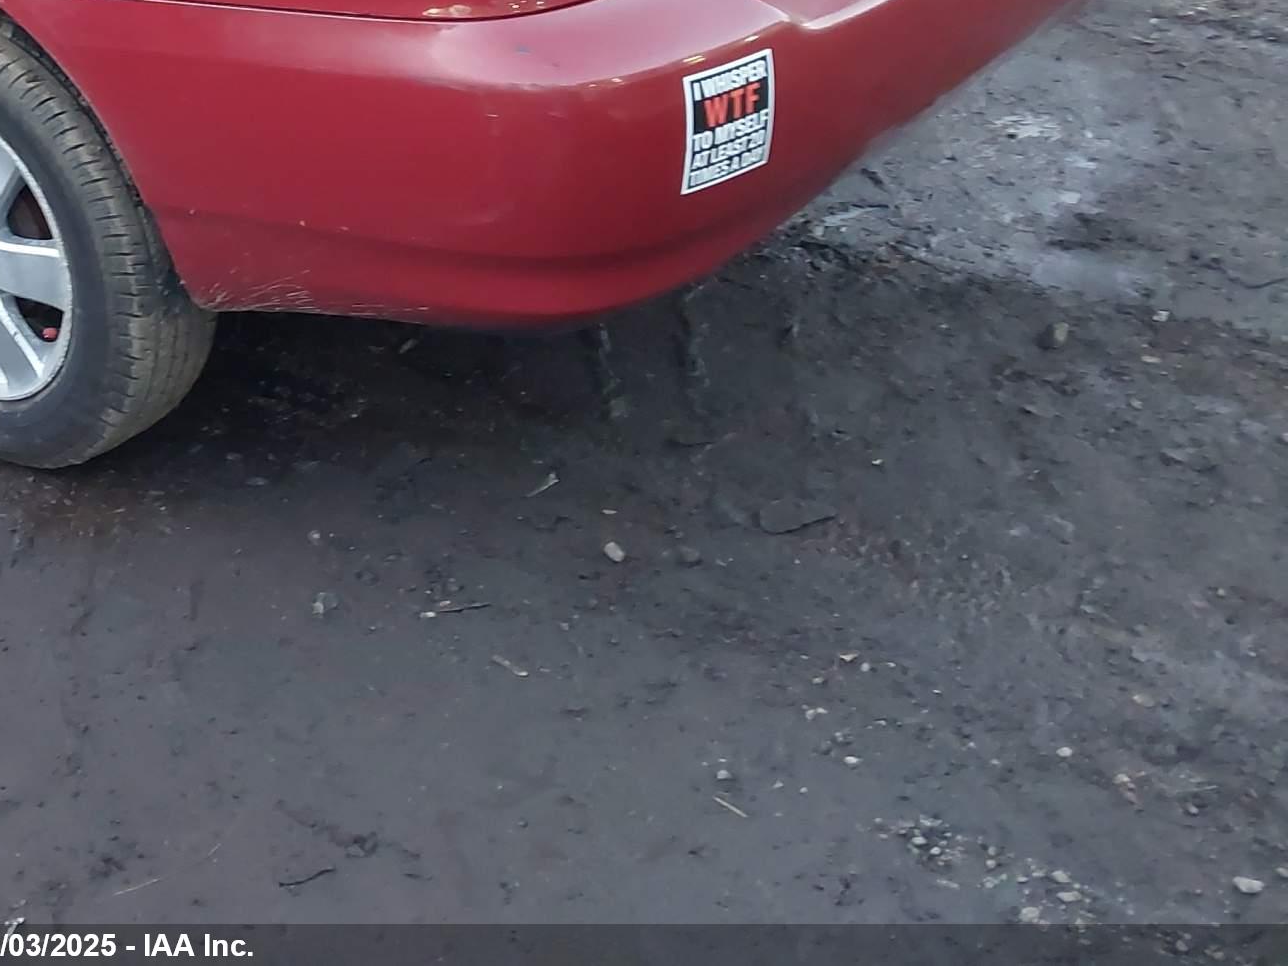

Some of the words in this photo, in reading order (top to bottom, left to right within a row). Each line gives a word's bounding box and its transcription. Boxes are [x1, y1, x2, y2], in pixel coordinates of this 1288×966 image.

[693, 81, 702, 101] I
[700, 59, 768, 98] WHISPER
[703, 82, 761, 127] WTF
[692, 130, 713, 151] TO
[714, 108, 769, 145] MYSELF
[691, 150, 710, 170] AT
[710, 137, 749, 164] LEAST
